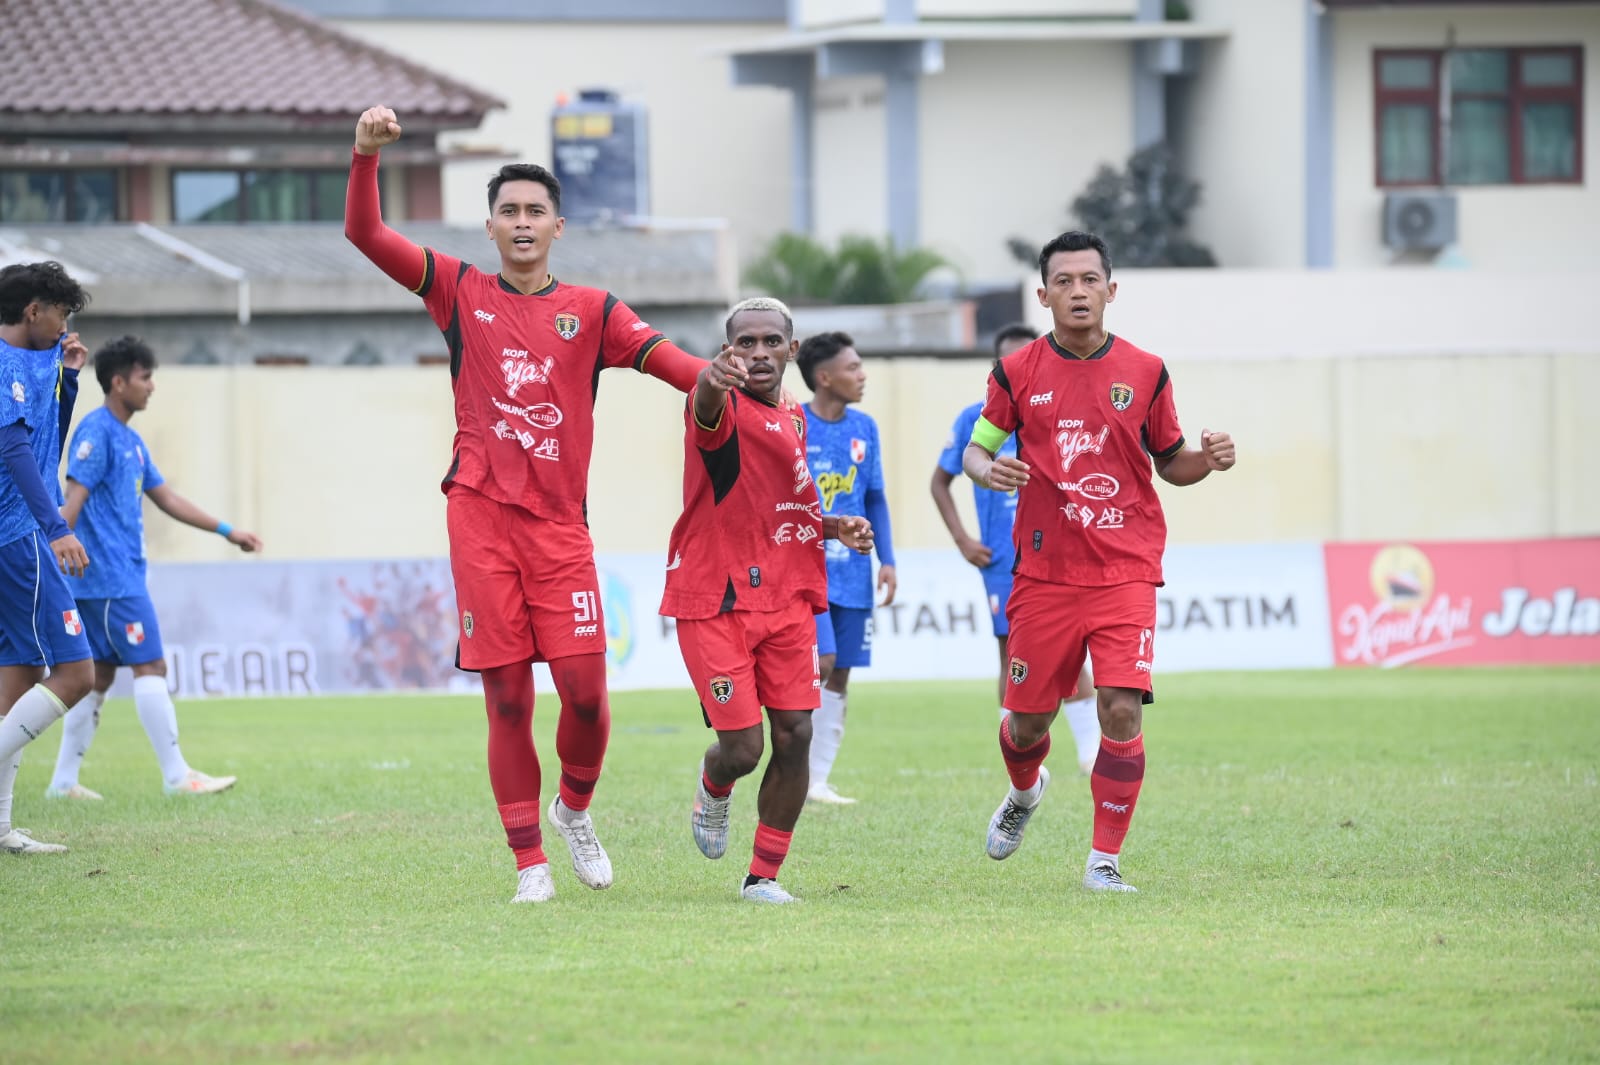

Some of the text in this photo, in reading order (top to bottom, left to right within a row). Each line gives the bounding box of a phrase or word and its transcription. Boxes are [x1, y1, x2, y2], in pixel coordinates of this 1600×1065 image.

[502, 348, 528, 358] KOPI
[1057, 419, 1084, 428] KOPI
[775, 502, 812, 512] SARUNG
[572, 591, 597, 622] 91
